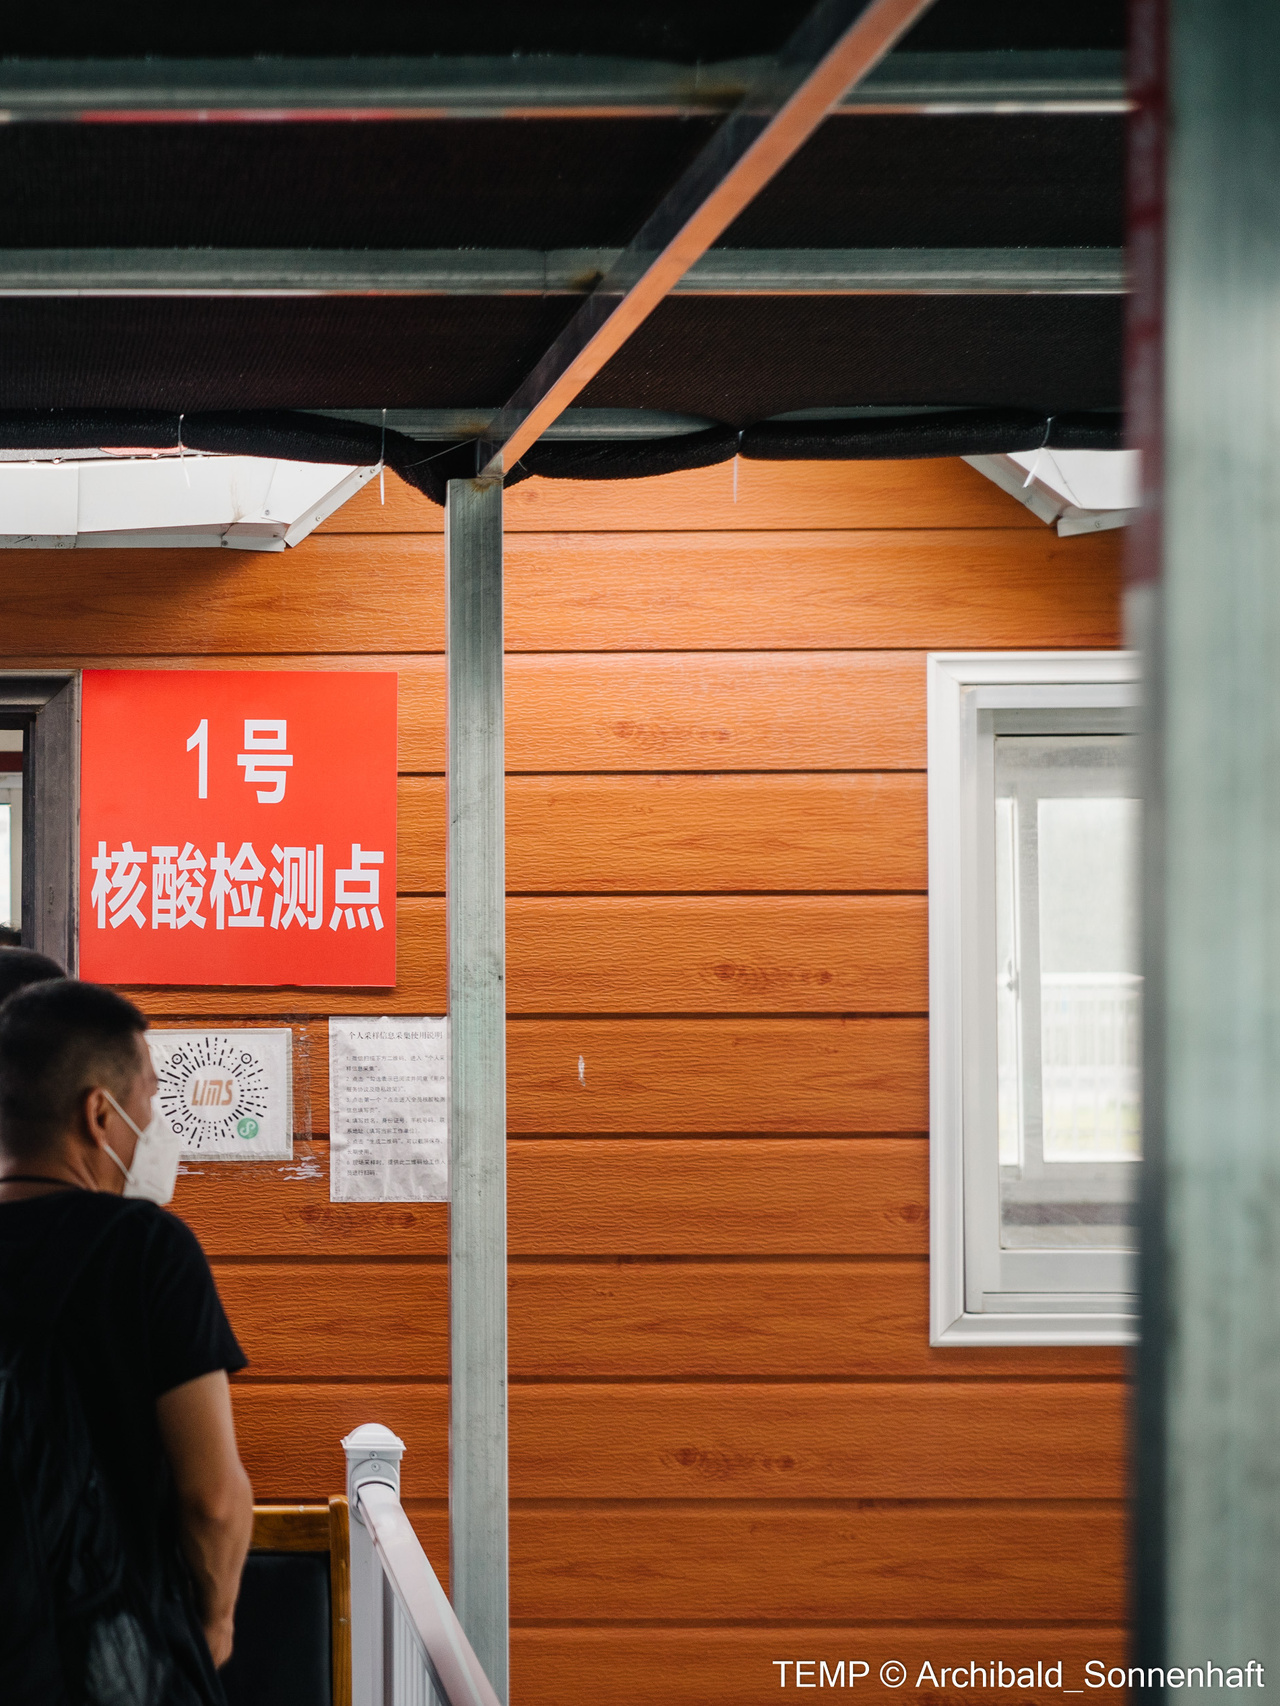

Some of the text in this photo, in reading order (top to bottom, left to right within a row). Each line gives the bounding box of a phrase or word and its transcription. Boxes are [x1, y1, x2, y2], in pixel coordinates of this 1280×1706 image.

[186, 718, 293, 803] 1号
[91, 841, 384, 931] 核酸检测点
